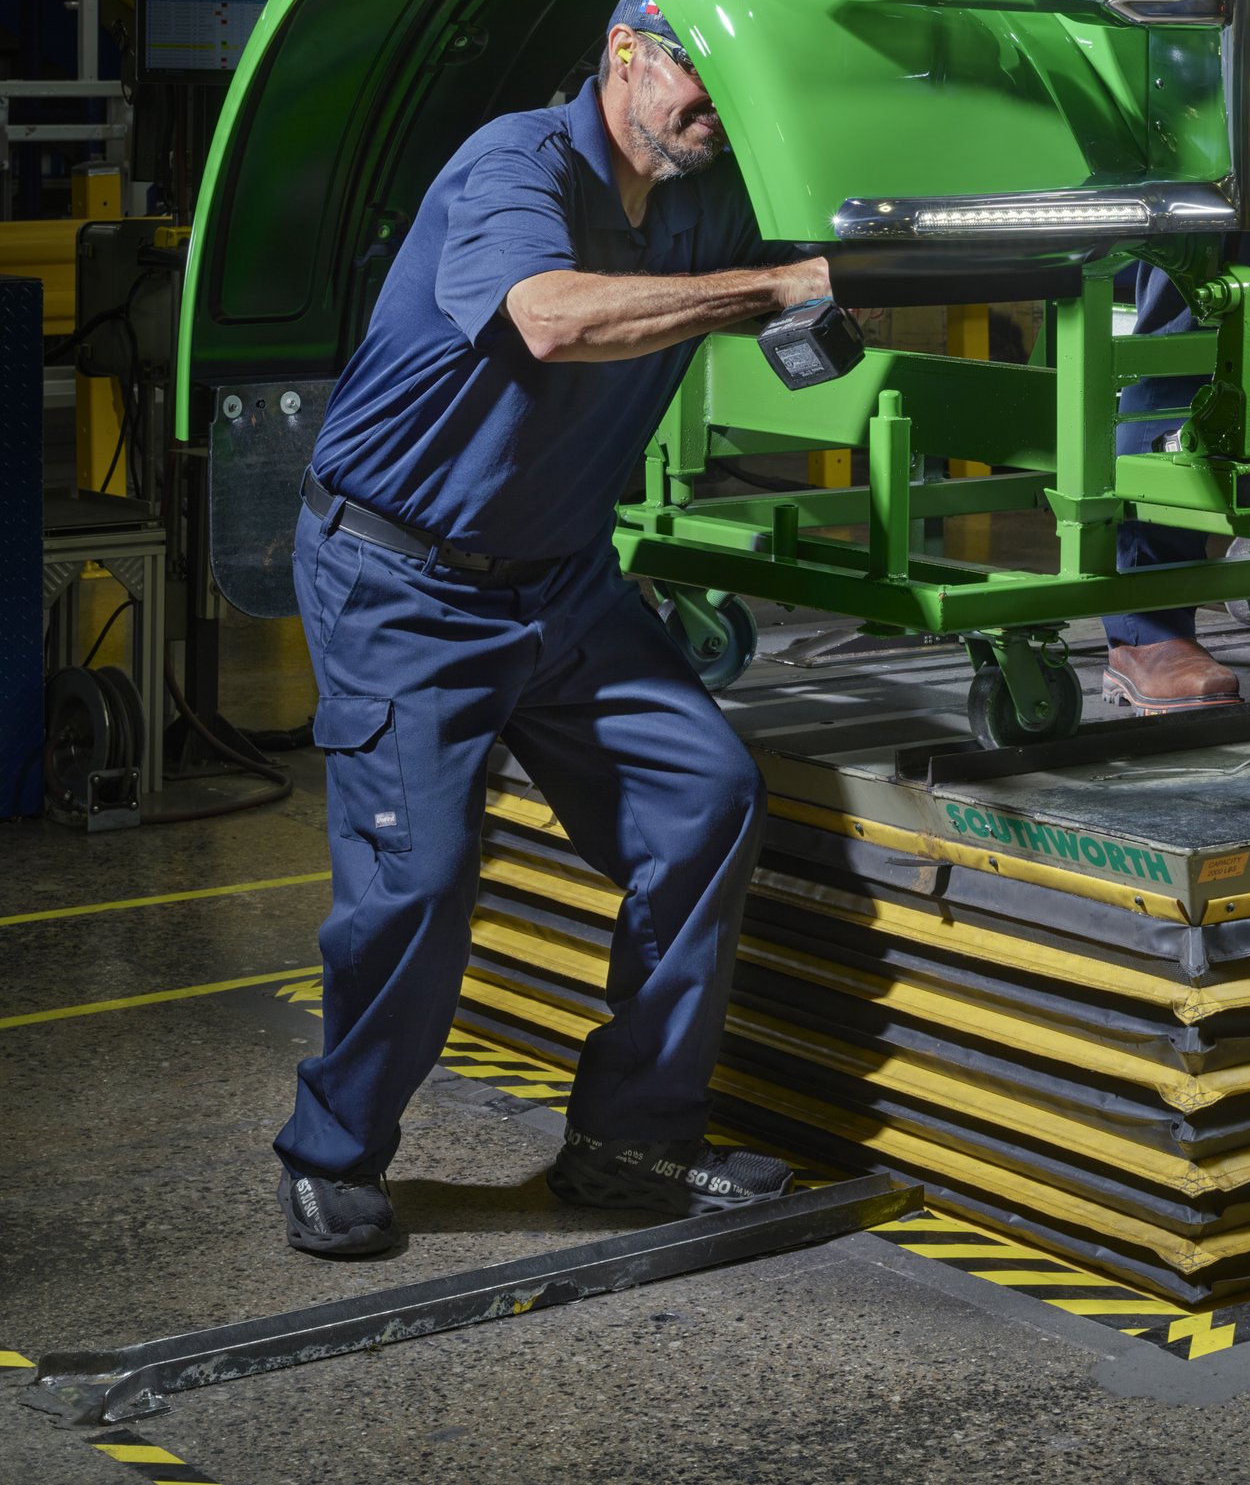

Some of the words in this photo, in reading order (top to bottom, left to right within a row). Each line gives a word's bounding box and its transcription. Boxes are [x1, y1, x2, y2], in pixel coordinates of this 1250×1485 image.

[946, 802, 1173, 885] SOUTHWORTH
[1208, 856, 1242, 869] CAPACITY
[1223, 865, 1238, 875] LBS
[650, 1159, 687, 1180] UST
[685, 1169, 708, 1186] SO
[708, 1176, 731, 1194] SO
